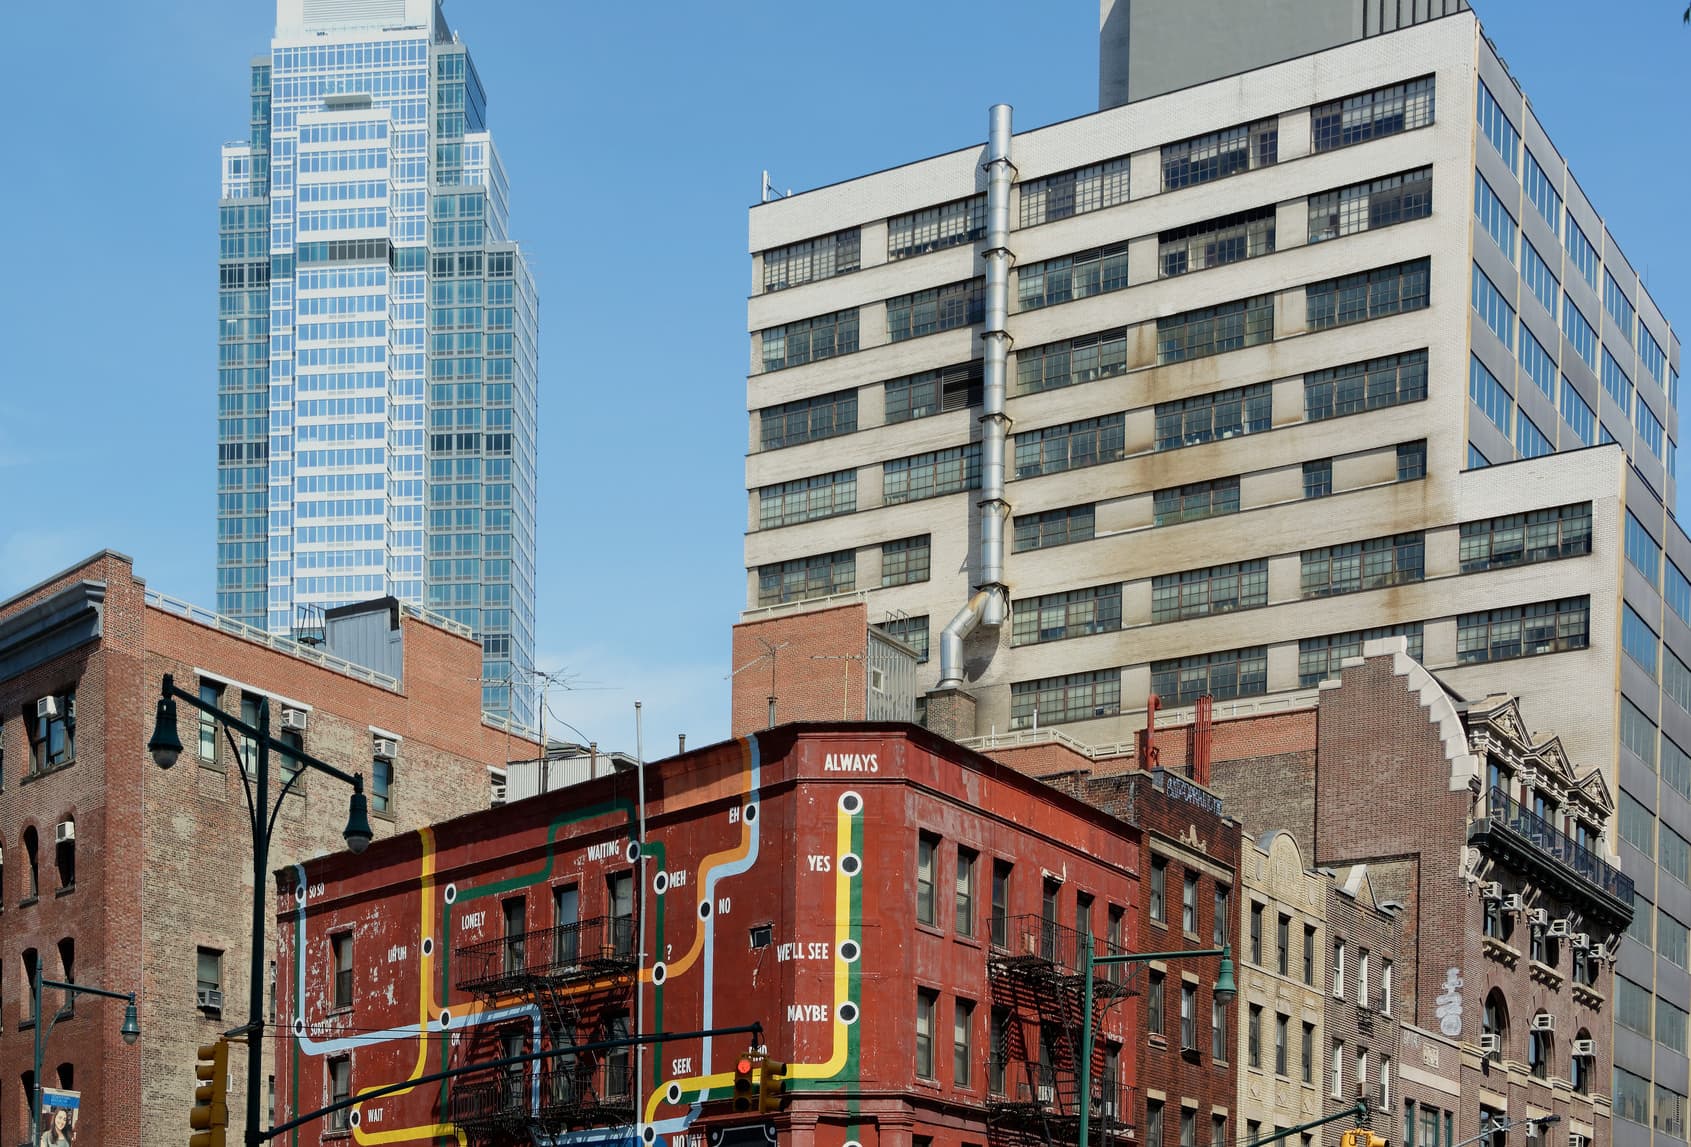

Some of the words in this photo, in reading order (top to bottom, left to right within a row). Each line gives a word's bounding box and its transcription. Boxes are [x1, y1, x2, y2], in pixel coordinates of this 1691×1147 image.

[824, 753, 878, 772] ALWAYS
[729, 807, 739, 824] EH
[587, 839, 619, 862] WAITING
[807, 855, 831, 872] YES
[669, 870, 686, 888] MEH
[718, 897, 731, 914] NO
[461, 910, 486, 930] LONELY
[667, 943, 673, 960] ?
[777, 942, 805, 962] WE'LL
[808, 943, 829, 959] SEE
[787, 1004, 828, 1022] MAYBE
[451, 1032, 461, 1046] OK
[672, 1058, 691, 1075] SEEK
[367, 1107, 384, 1123] WAIT
